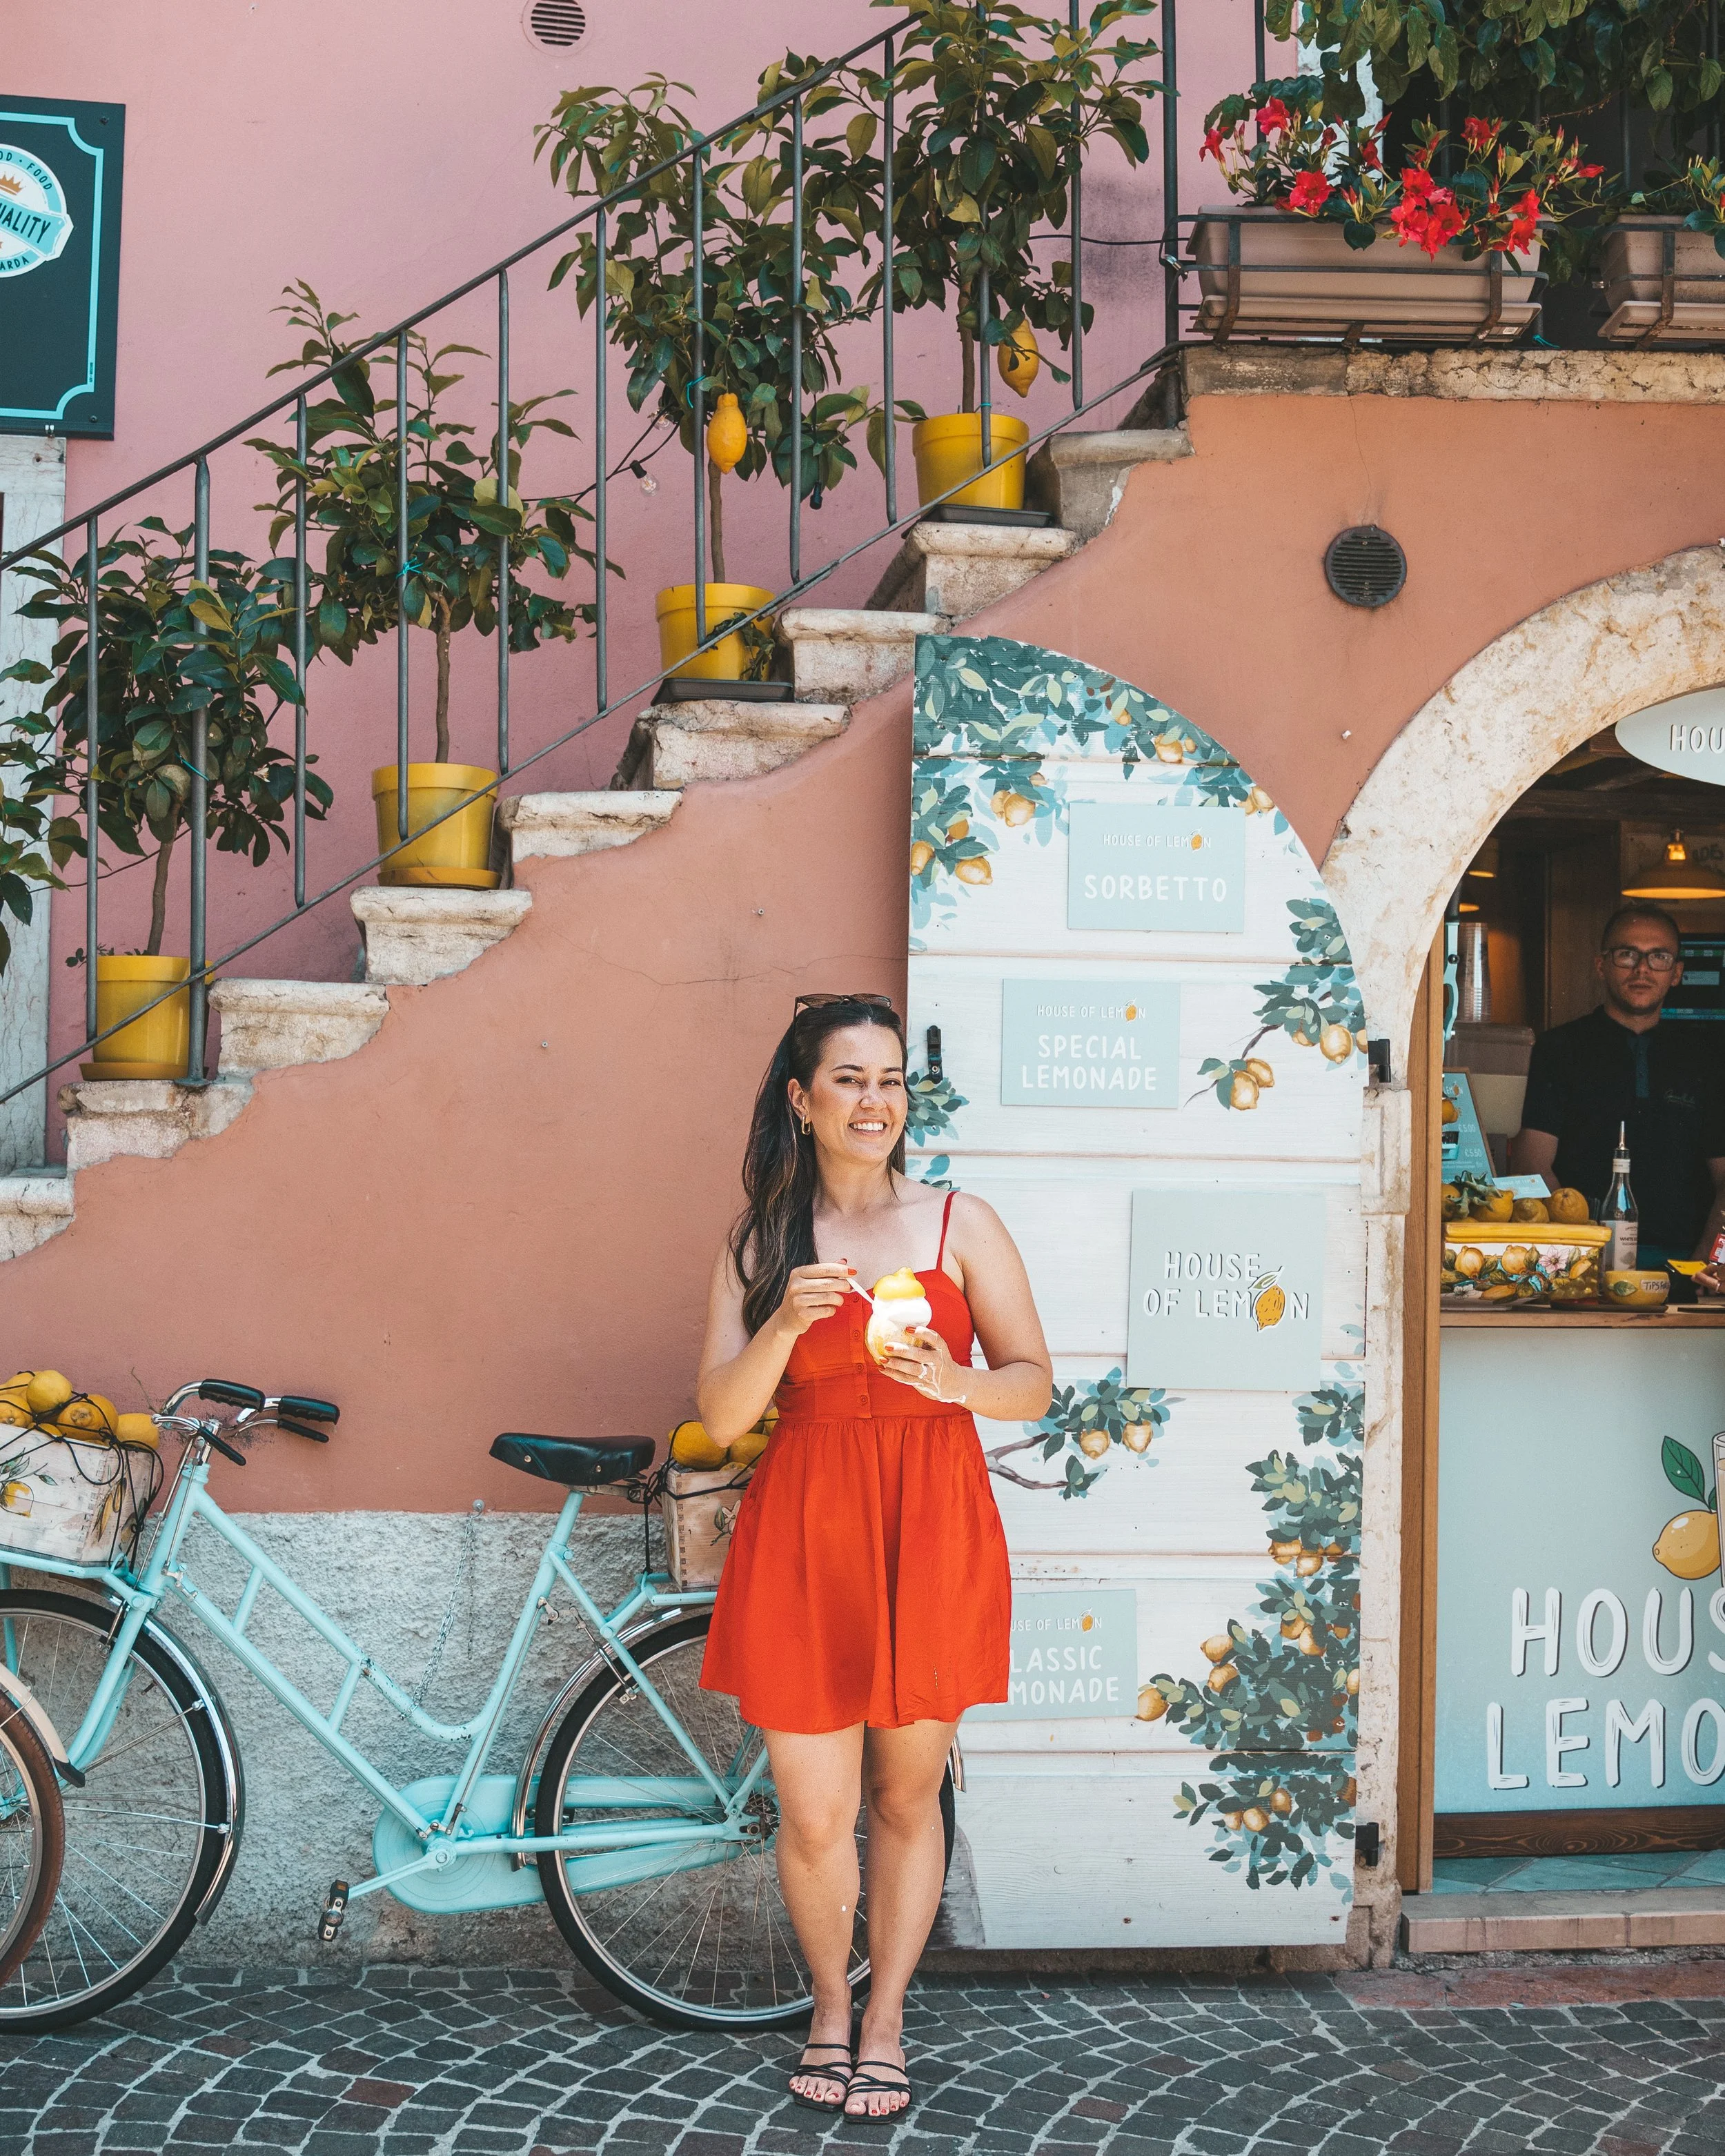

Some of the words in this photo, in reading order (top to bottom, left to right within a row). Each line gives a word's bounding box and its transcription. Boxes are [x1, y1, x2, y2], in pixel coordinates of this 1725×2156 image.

[26, 162, 52, 190] FOOD
[1103, 833, 1141, 848] HOUSE
[1145, 835, 1161, 848] OF
[1084, 873, 1227, 902] SORBETTO
[1036, 1004, 1076, 1018] HOUSE
[1080, 1006, 1095, 1018] OF
[1038, 1034, 1142, 1060] SPECIAL
[1021, 1064, 1157, 1091] LEMONADE
[1163, 1250, 1261, 1283] HOUSE
[1143, 1287, 1181, 1317] OF
[1036, 1619, 1052, 1631] OF
[1486, 1697, 1725, 1790] LEMO
